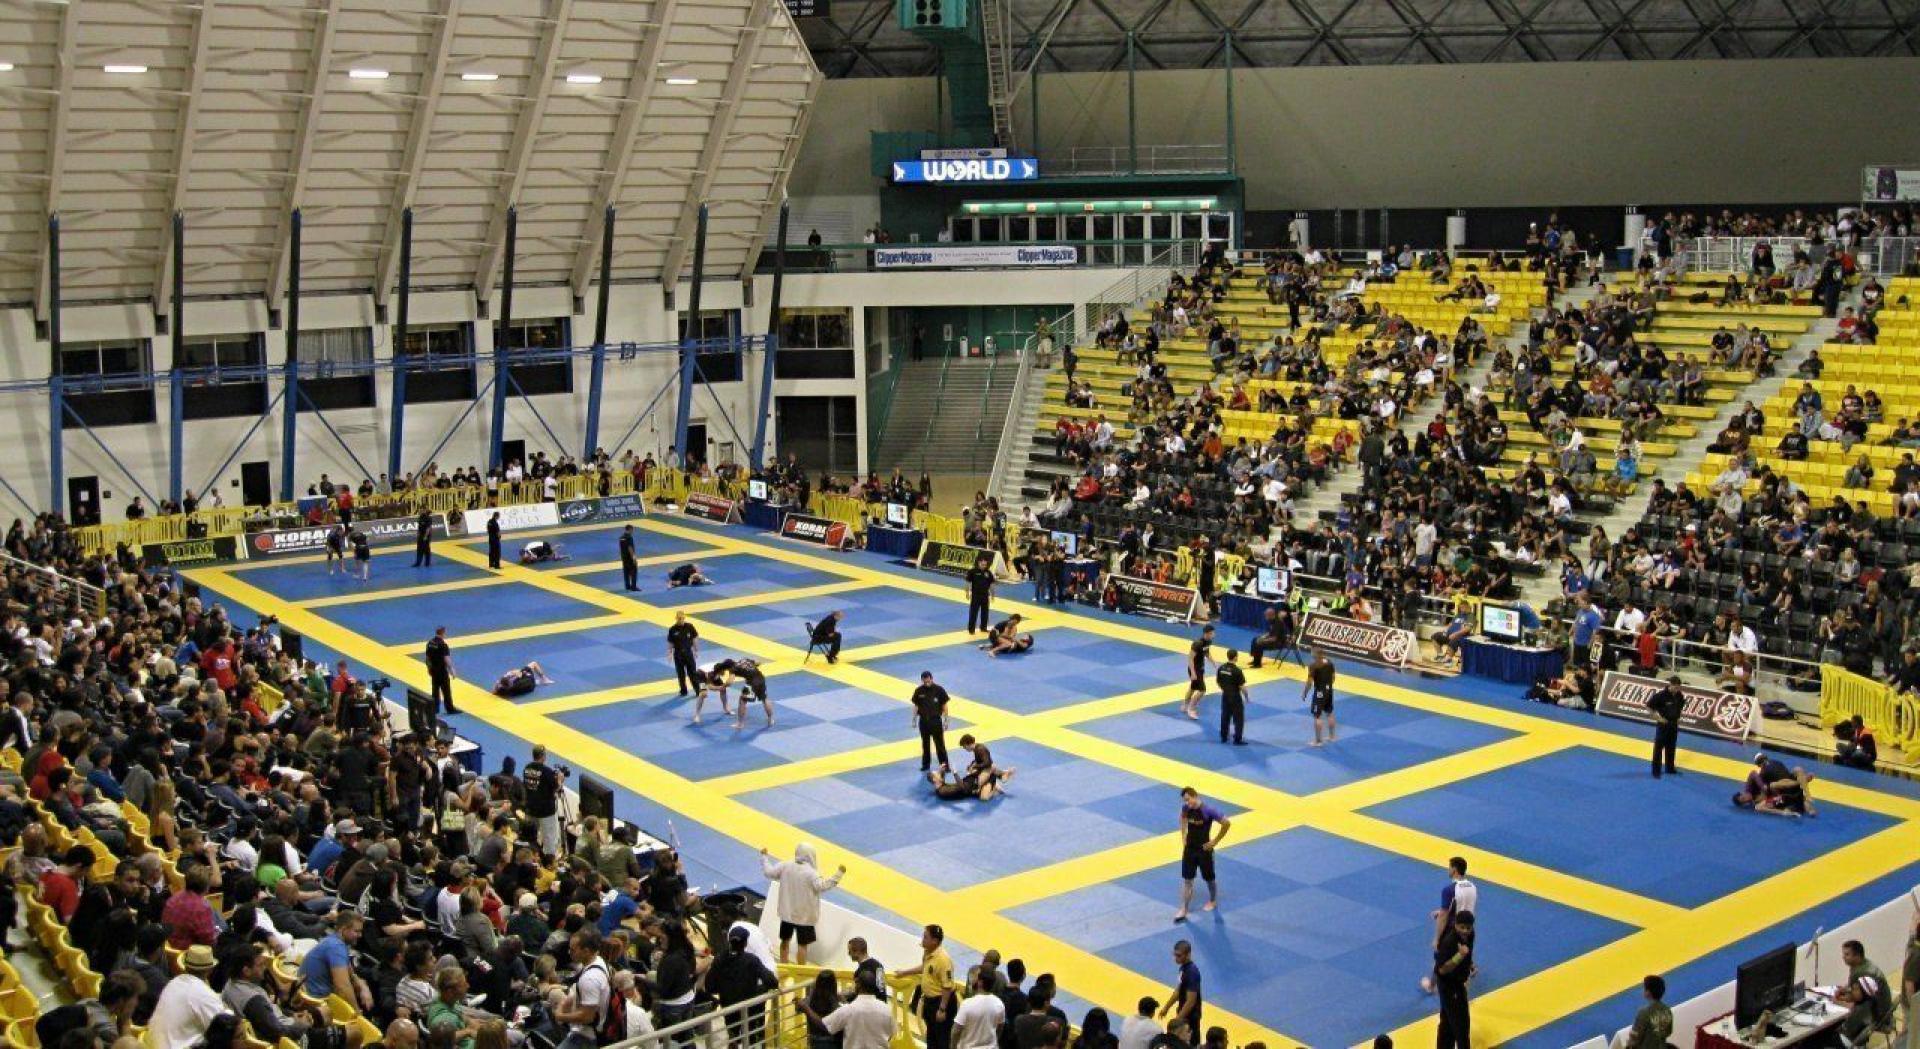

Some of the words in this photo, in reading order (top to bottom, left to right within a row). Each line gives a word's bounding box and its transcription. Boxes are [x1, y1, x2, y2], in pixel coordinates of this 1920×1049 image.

[923, 160, 1010, 181] WORLD
[1306, 617, 1384, 650] KEIKOSPORTS
[1608, 679, 1716, 719] KEIKORTS
